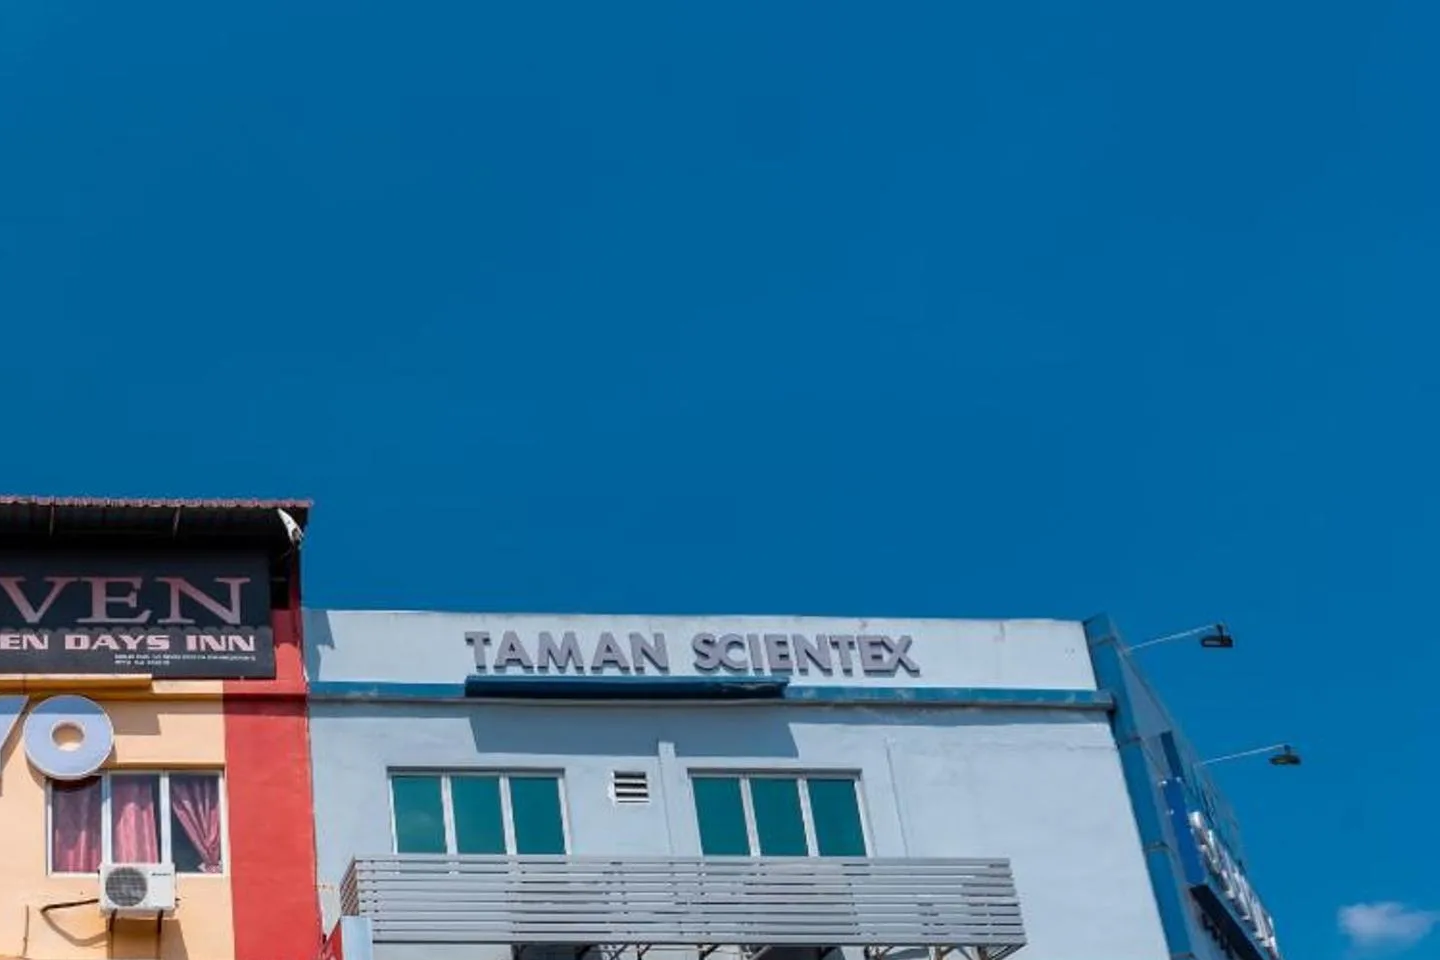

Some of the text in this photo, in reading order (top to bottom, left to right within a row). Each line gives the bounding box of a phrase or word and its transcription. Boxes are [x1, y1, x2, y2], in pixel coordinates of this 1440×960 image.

[65, 634, 170, 652] DAYS
[186, 634, 255, 652] INN
[465, 630, 921, 677] TAMAN SCIENTEX
